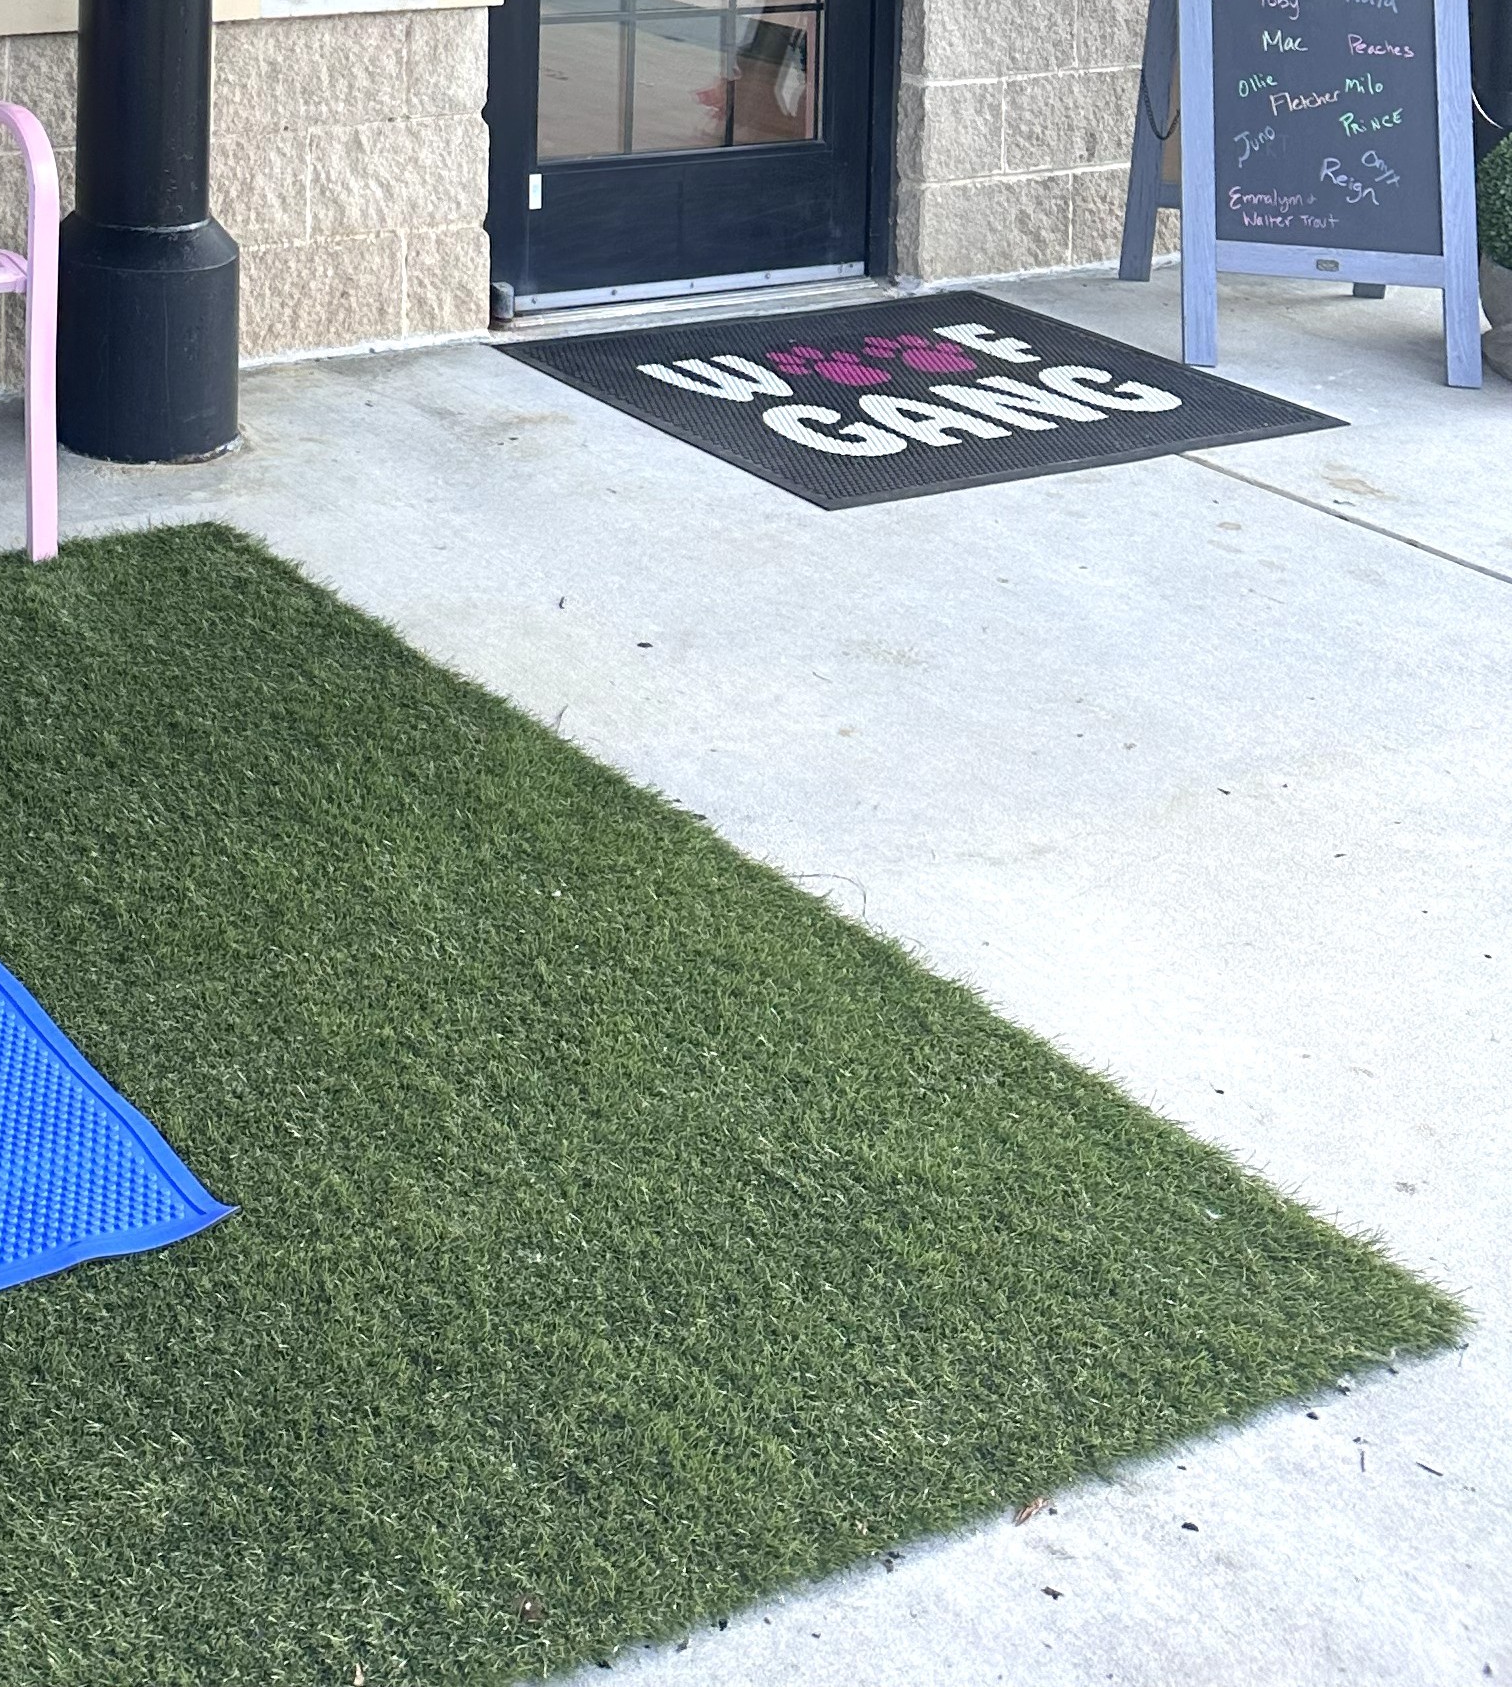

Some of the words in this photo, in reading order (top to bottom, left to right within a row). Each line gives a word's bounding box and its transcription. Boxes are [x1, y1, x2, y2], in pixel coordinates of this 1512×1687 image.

[1262, 29, 1309, 53] Mac
[1347, 33, 1415, 59] Peaches
[1238, 73, 1279, 98] Ollie
[1269, 89, 1341, 117] Fletcher
[1233, 125, 1276, 169] Juno
[1320, 157, 1380, 206] Reign
[1242, 211, 1294, 229] Walter
[763, 364, 1182, 458] GANG
